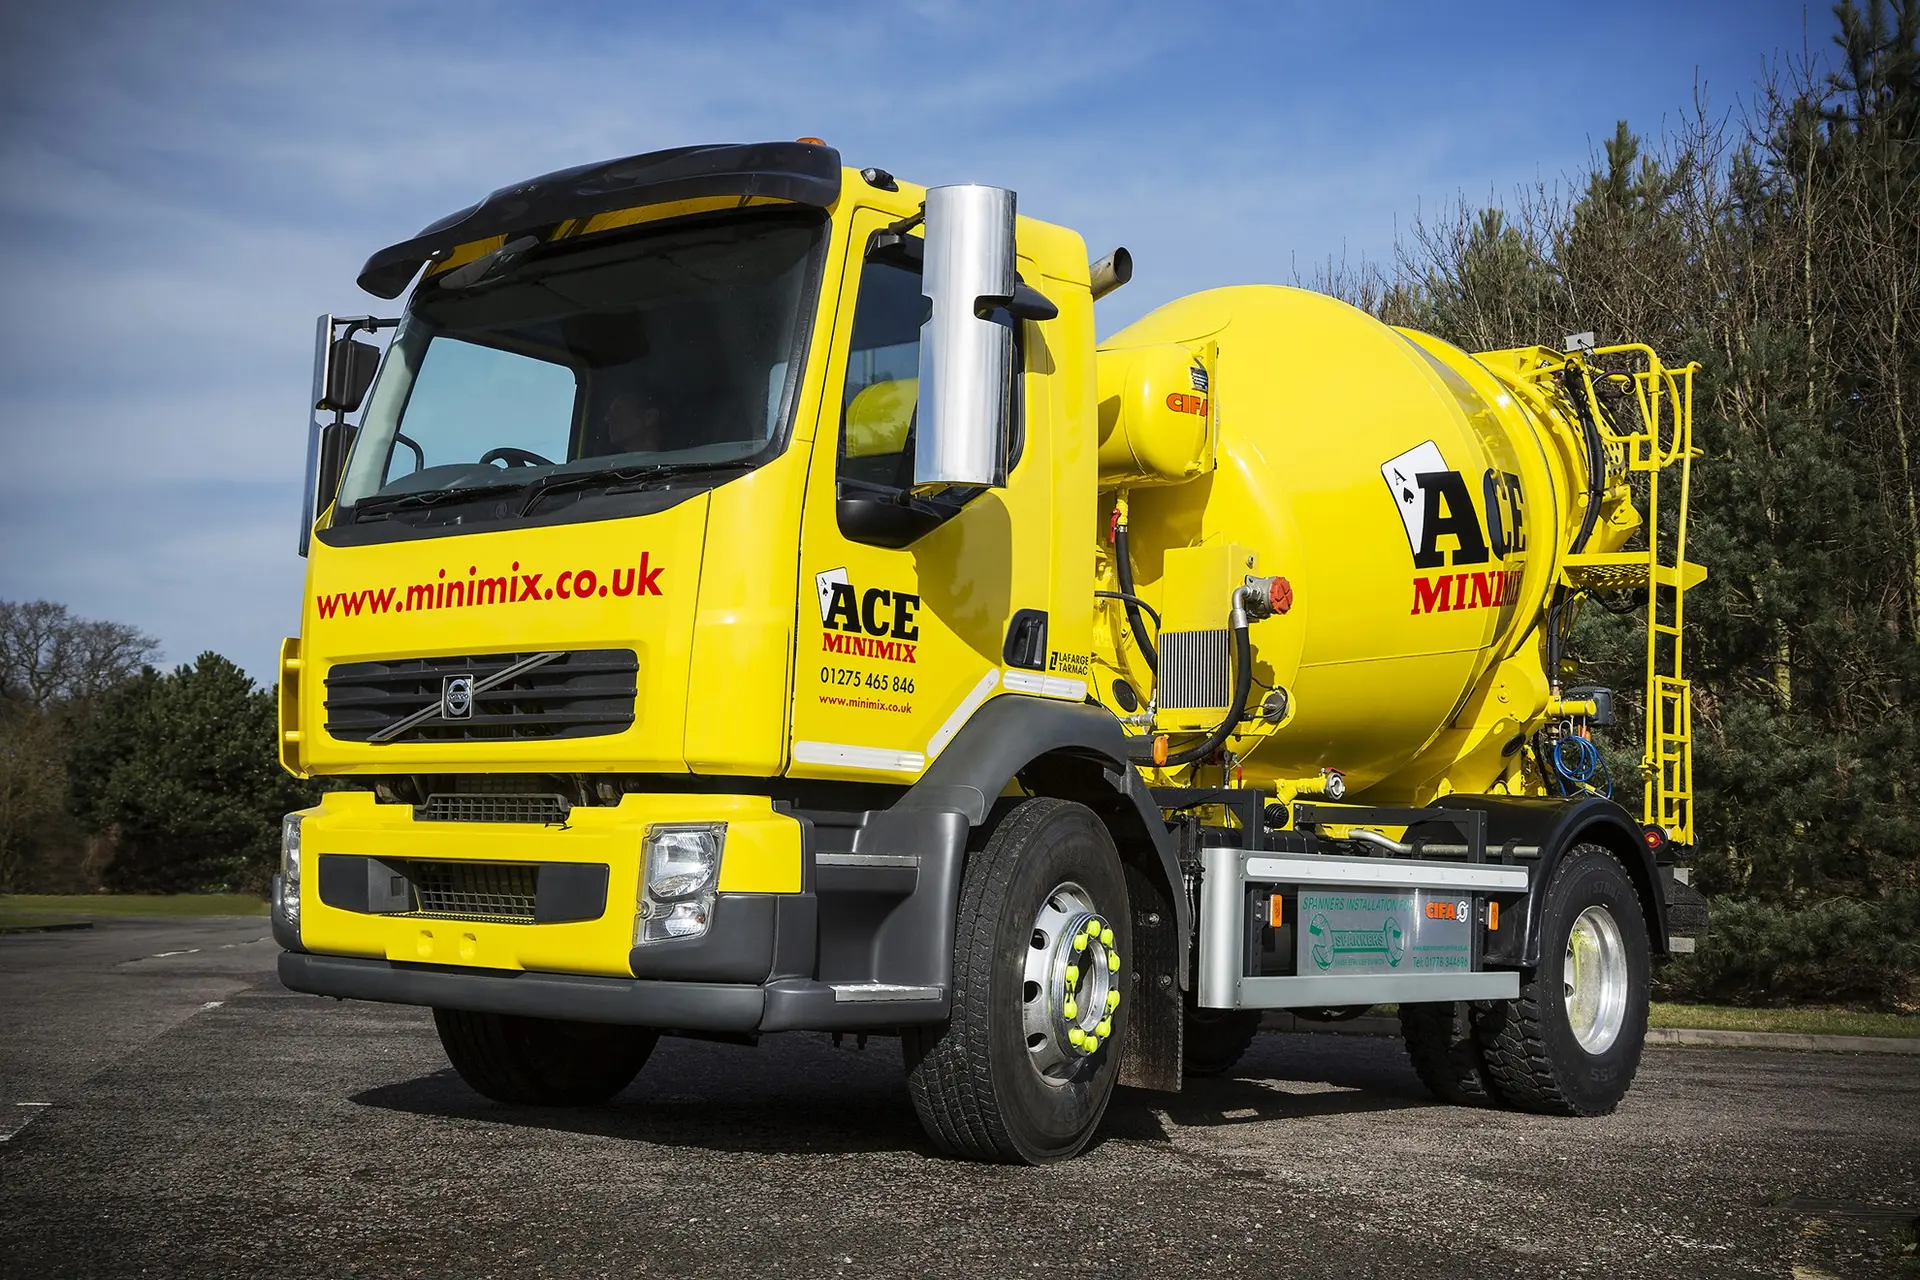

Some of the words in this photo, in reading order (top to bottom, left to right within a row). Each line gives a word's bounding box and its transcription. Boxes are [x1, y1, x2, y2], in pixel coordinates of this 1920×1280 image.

[1415, 471, 1526, 569] ACE
[317, 552, 664, 619] www.minimix.co.uk
[823, 582, 920, 641] ACE
[822, 632, 917, 663] MINIMIX
[1059, 652, 1089, 665] LAFARGE
[1059, 663, 1088, 675] TARMAC
[820, 667, 861, 687] 01275
[865, 673, 888, 691] 465
[892, 676, 915, 694] 846
[819, 695, 912, 713] www.minimix.co.uk
[1303, 897, 1344, 910] SPANNERS
[1346, 898, 1397, 911] INSTALLATION
[1425, 902, 1457, 920] CIFA
[1335, 933, 1384, 947] SPANNERS
